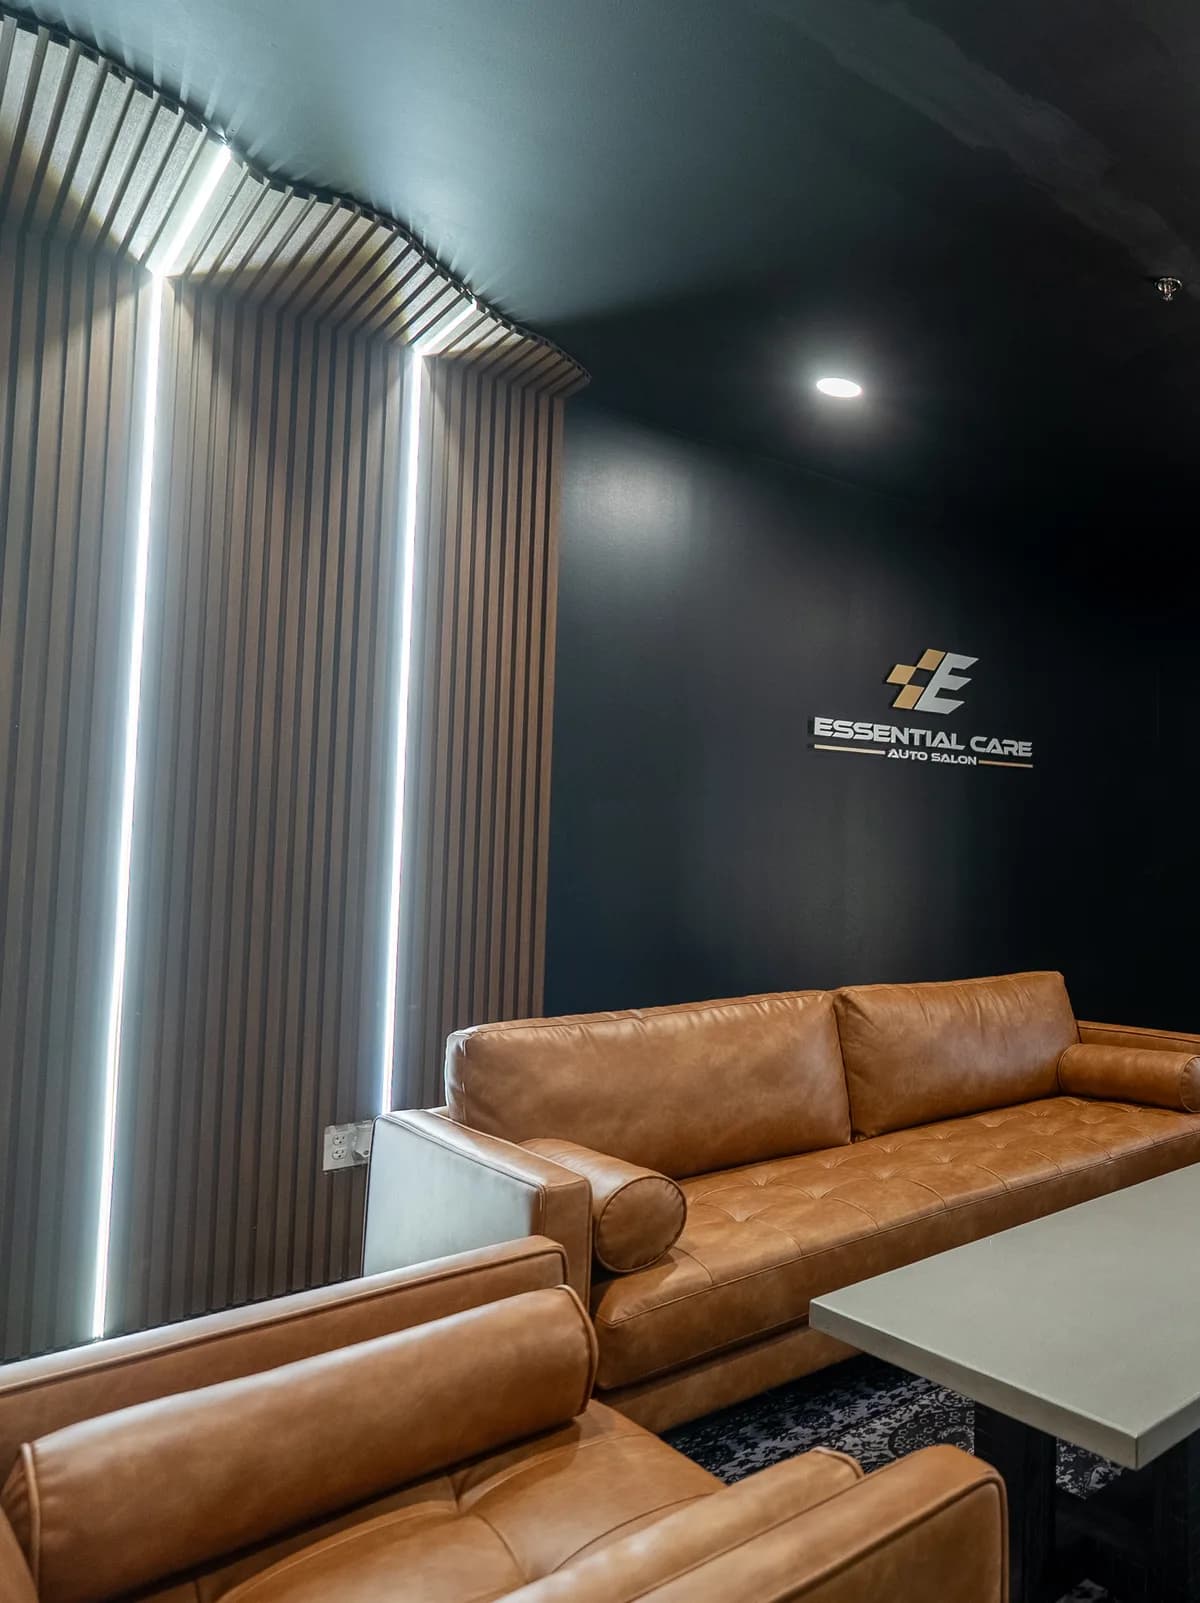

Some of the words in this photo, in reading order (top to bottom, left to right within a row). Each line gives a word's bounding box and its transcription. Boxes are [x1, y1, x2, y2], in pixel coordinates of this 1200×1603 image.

[813, 716, 966, 751] ESSENTIAL
[969, 735, 1033, 757] CARE
[887, 748, 928, 761] AUTO
[930, 752, 977, 766] SALON
